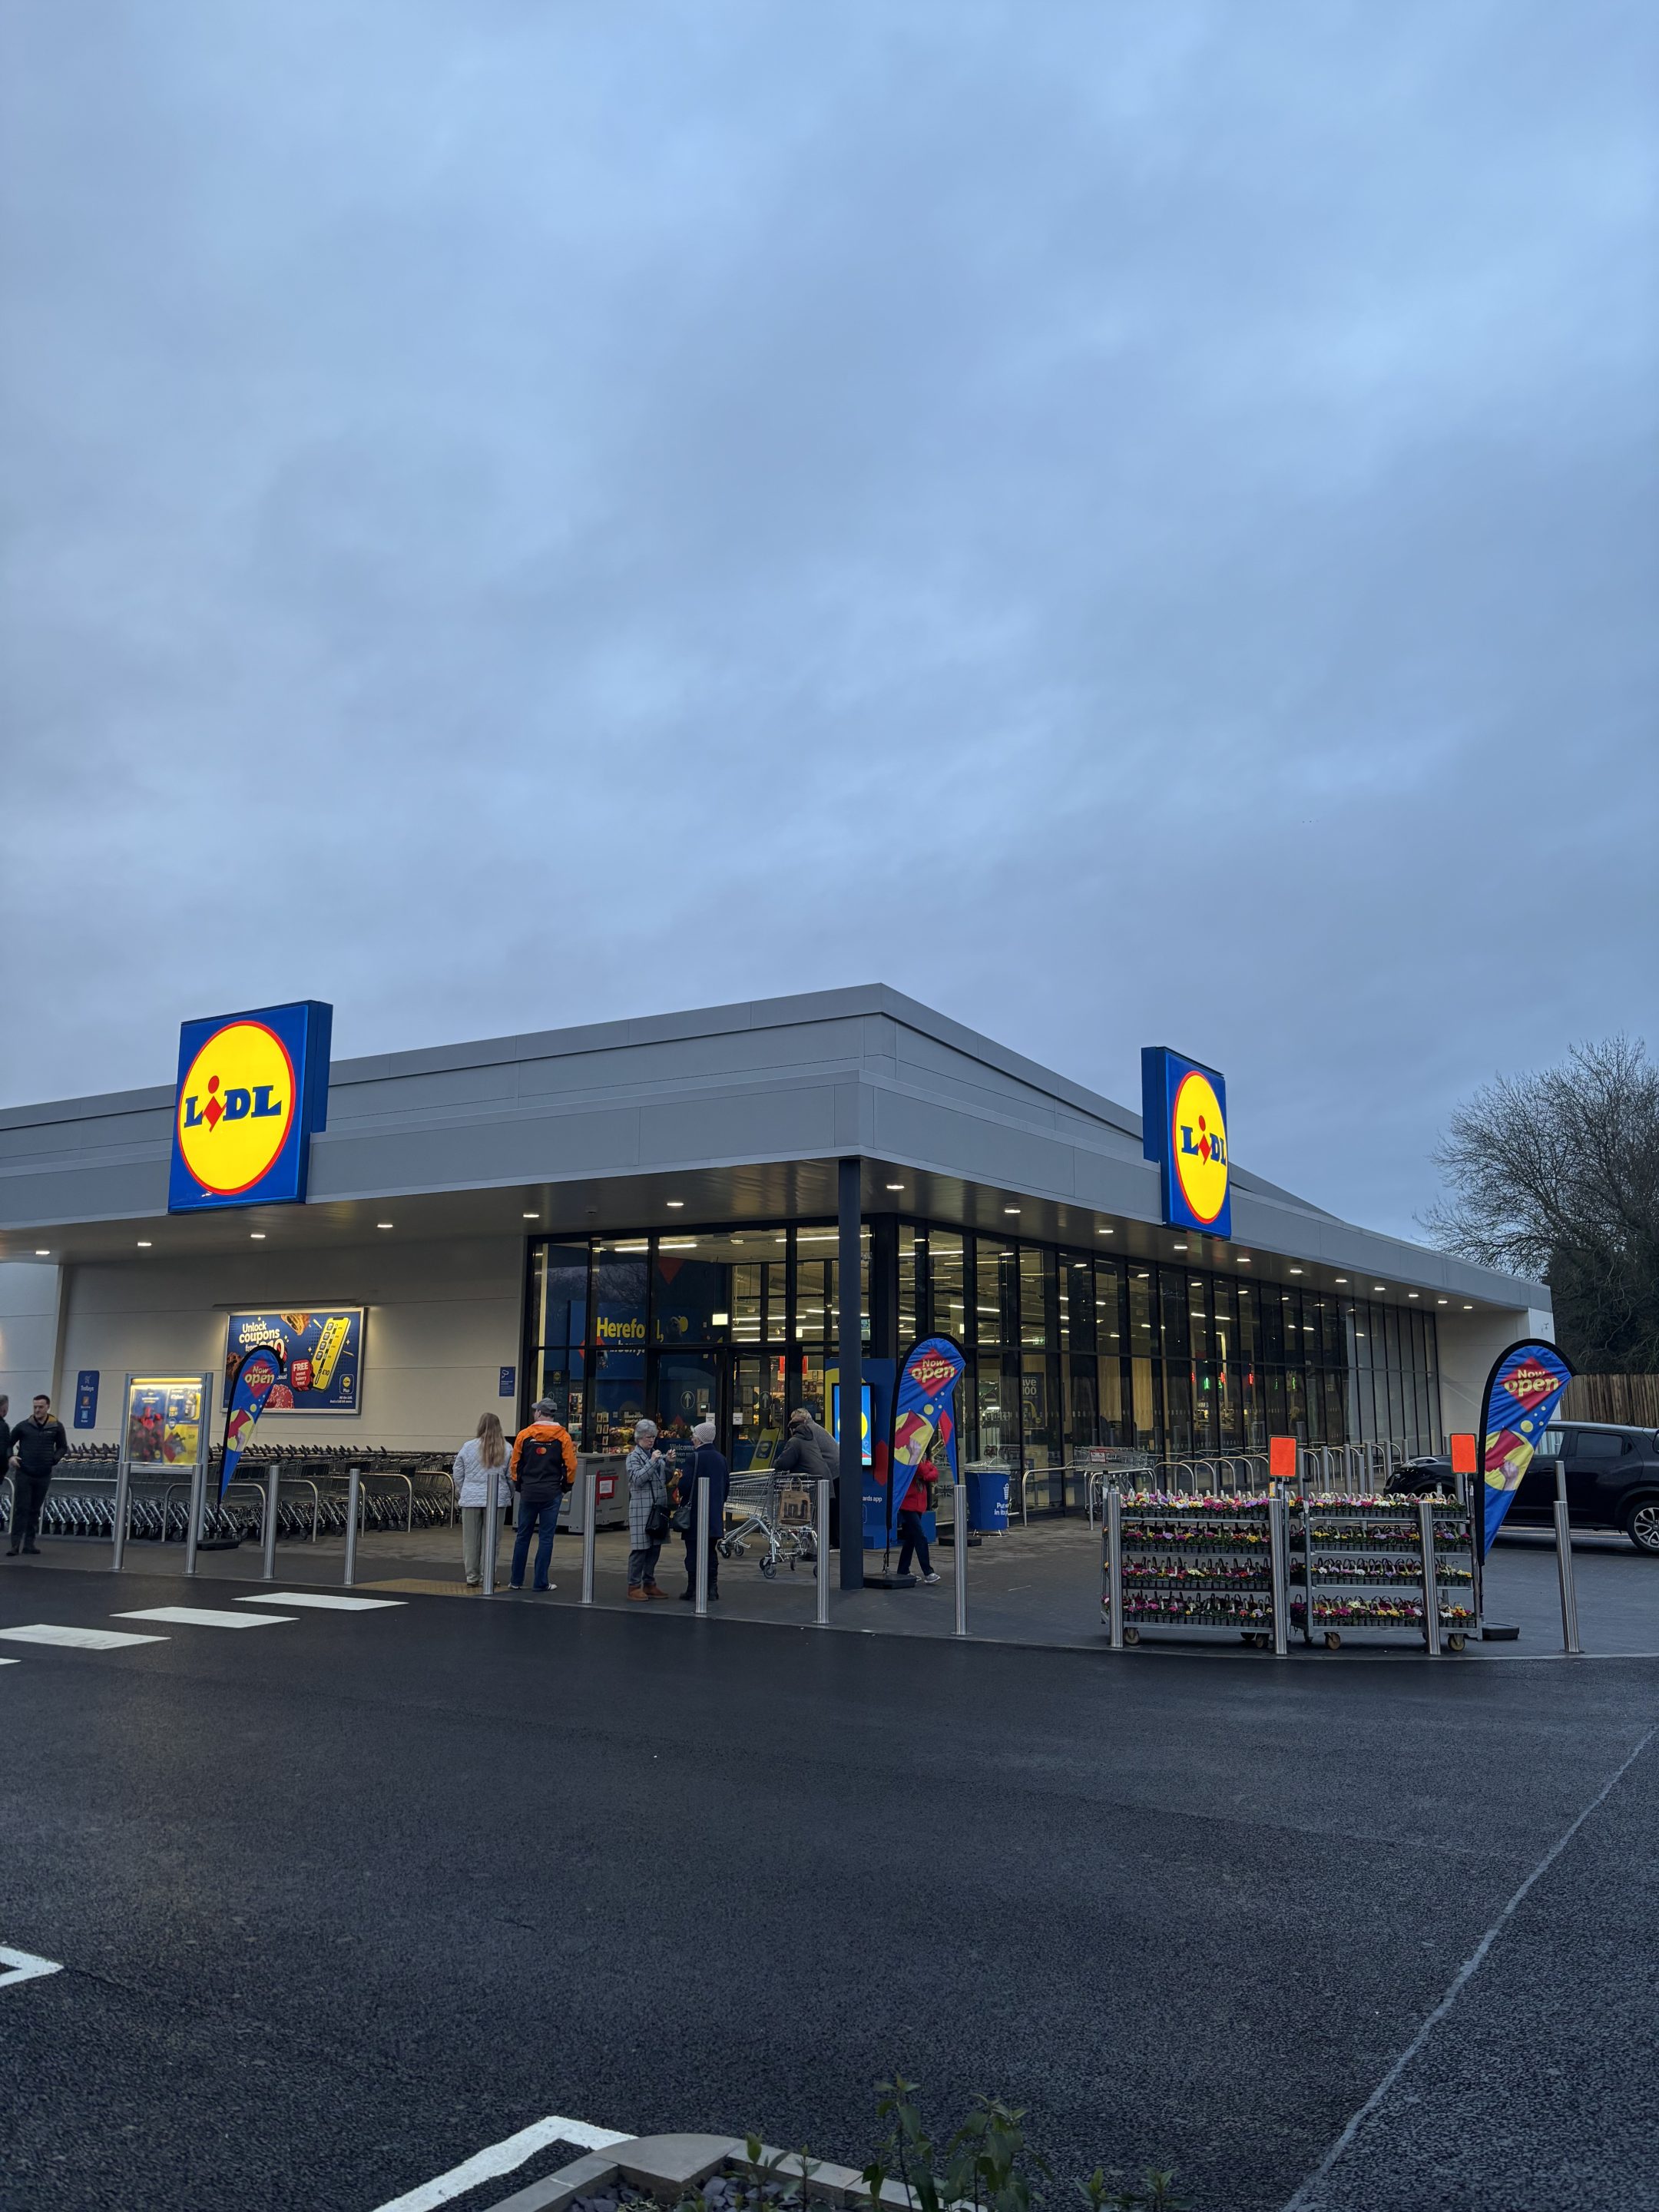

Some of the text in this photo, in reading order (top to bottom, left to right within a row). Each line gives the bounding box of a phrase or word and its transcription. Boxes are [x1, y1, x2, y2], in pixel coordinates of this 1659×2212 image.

[243, 1321, 267, 1333] Unlock
[239, 1329, 280, 1344] coupons
[293, 1362, 309, 1372] FREE
[922, 1359, 945, 1367] Now
[244, 1373, 275, 1387] open
[911, 1366, 955, 1382] open
[1517, 1369, 1545, 1379] Now
[1504, 1377, 1559, 1397] open
